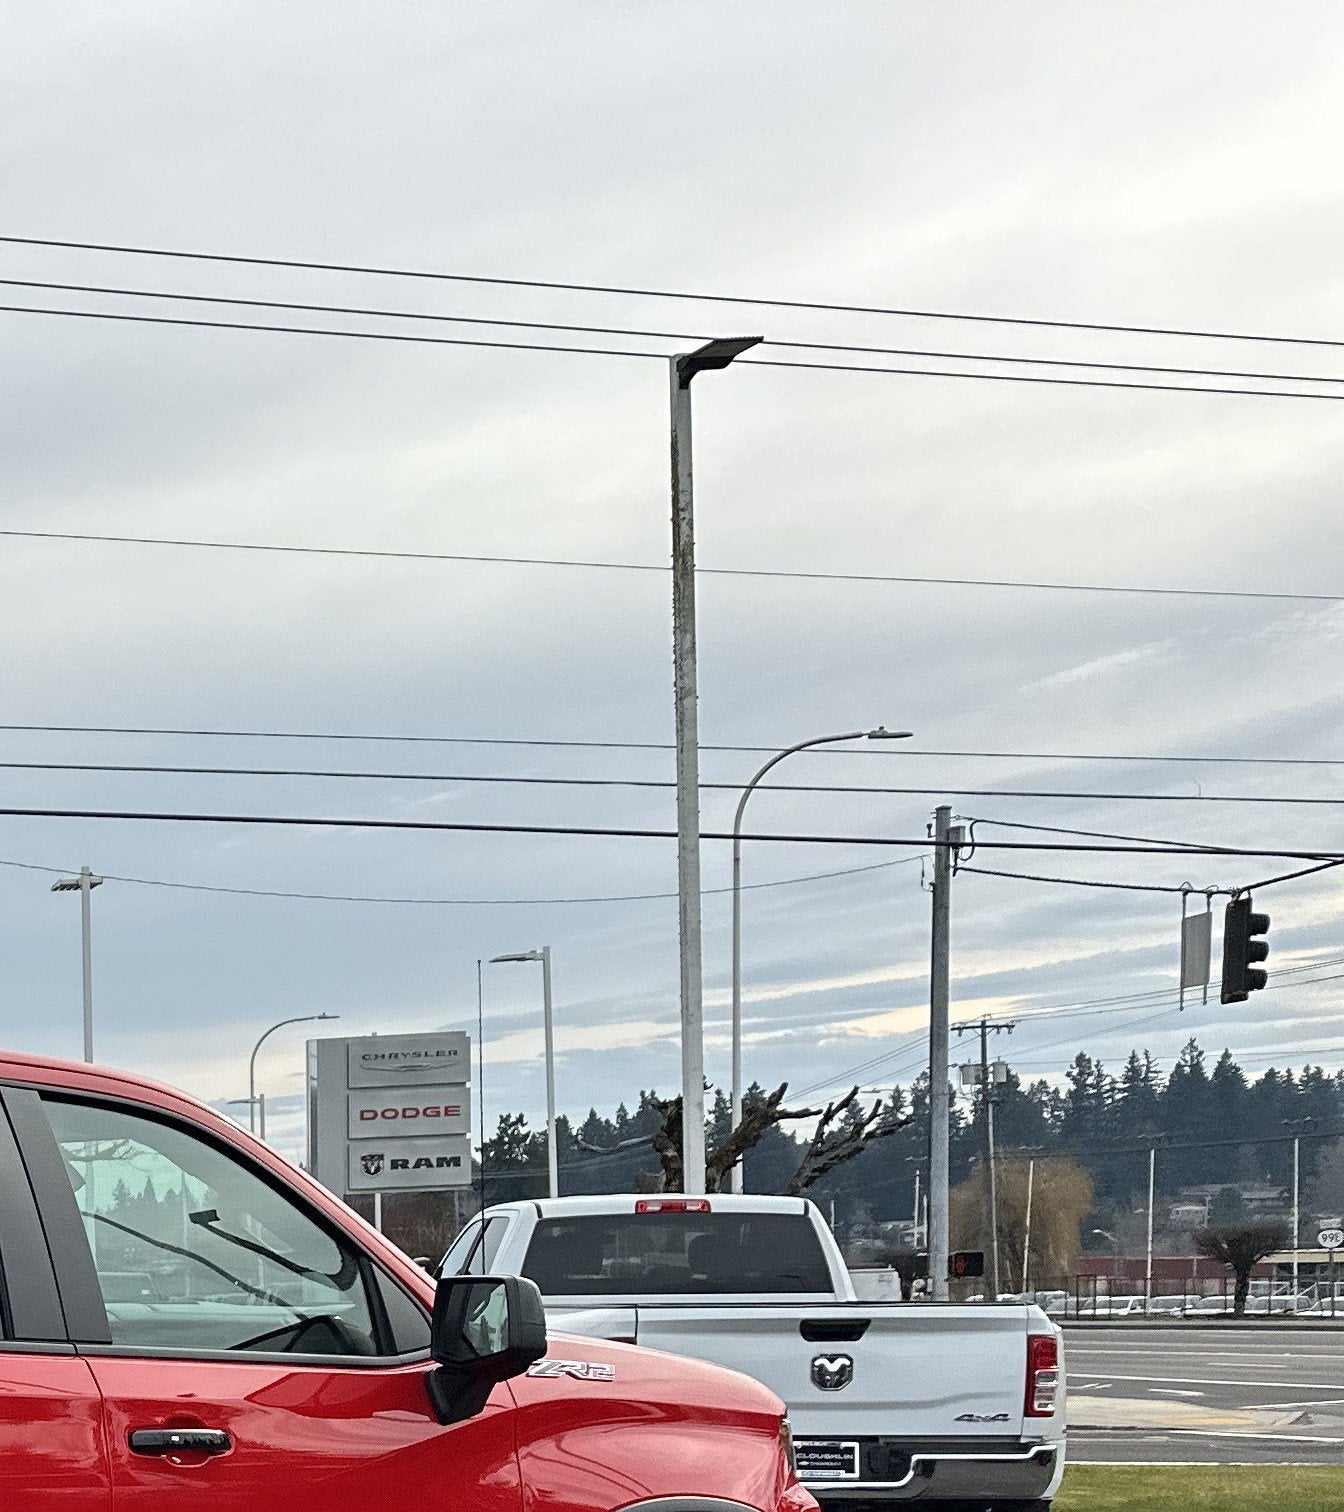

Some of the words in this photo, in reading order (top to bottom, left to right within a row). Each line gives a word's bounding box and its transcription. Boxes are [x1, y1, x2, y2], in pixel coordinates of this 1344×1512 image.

[361, 1049, 458, 1061] CHRYSLER
[359, 1105, 462, 1121] DODGE
[390, 1156, 461, 1170] RAM
[525, 1360, 616, 1382] ZR2
